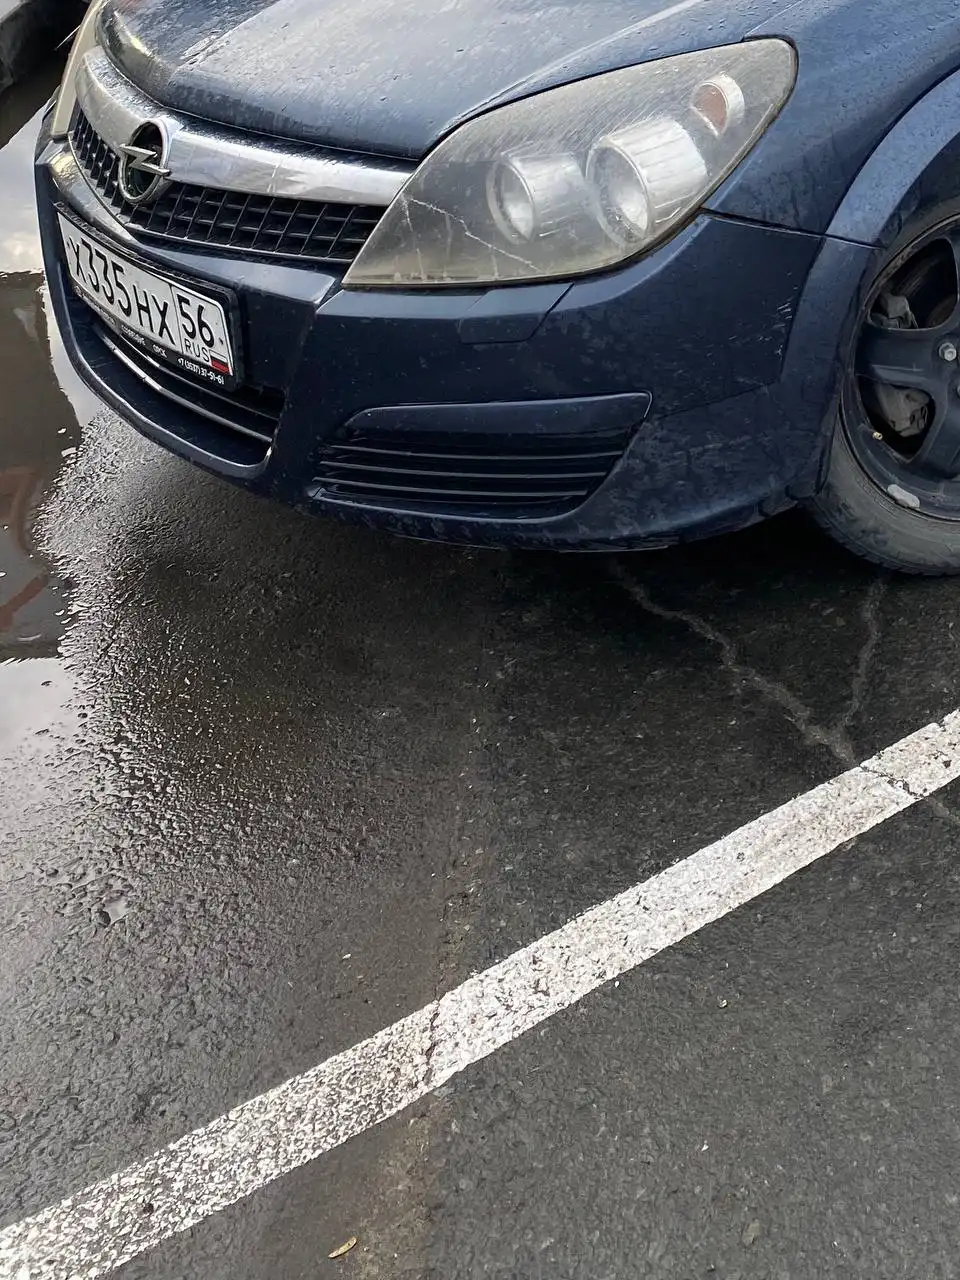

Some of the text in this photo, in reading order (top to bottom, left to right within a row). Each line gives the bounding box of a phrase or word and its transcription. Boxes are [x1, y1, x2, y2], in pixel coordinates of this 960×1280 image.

[68, 236, 176, 346] Х335НХ
[177, 293, 215, 348] 56
[183, 337, 211, 363] RUS
